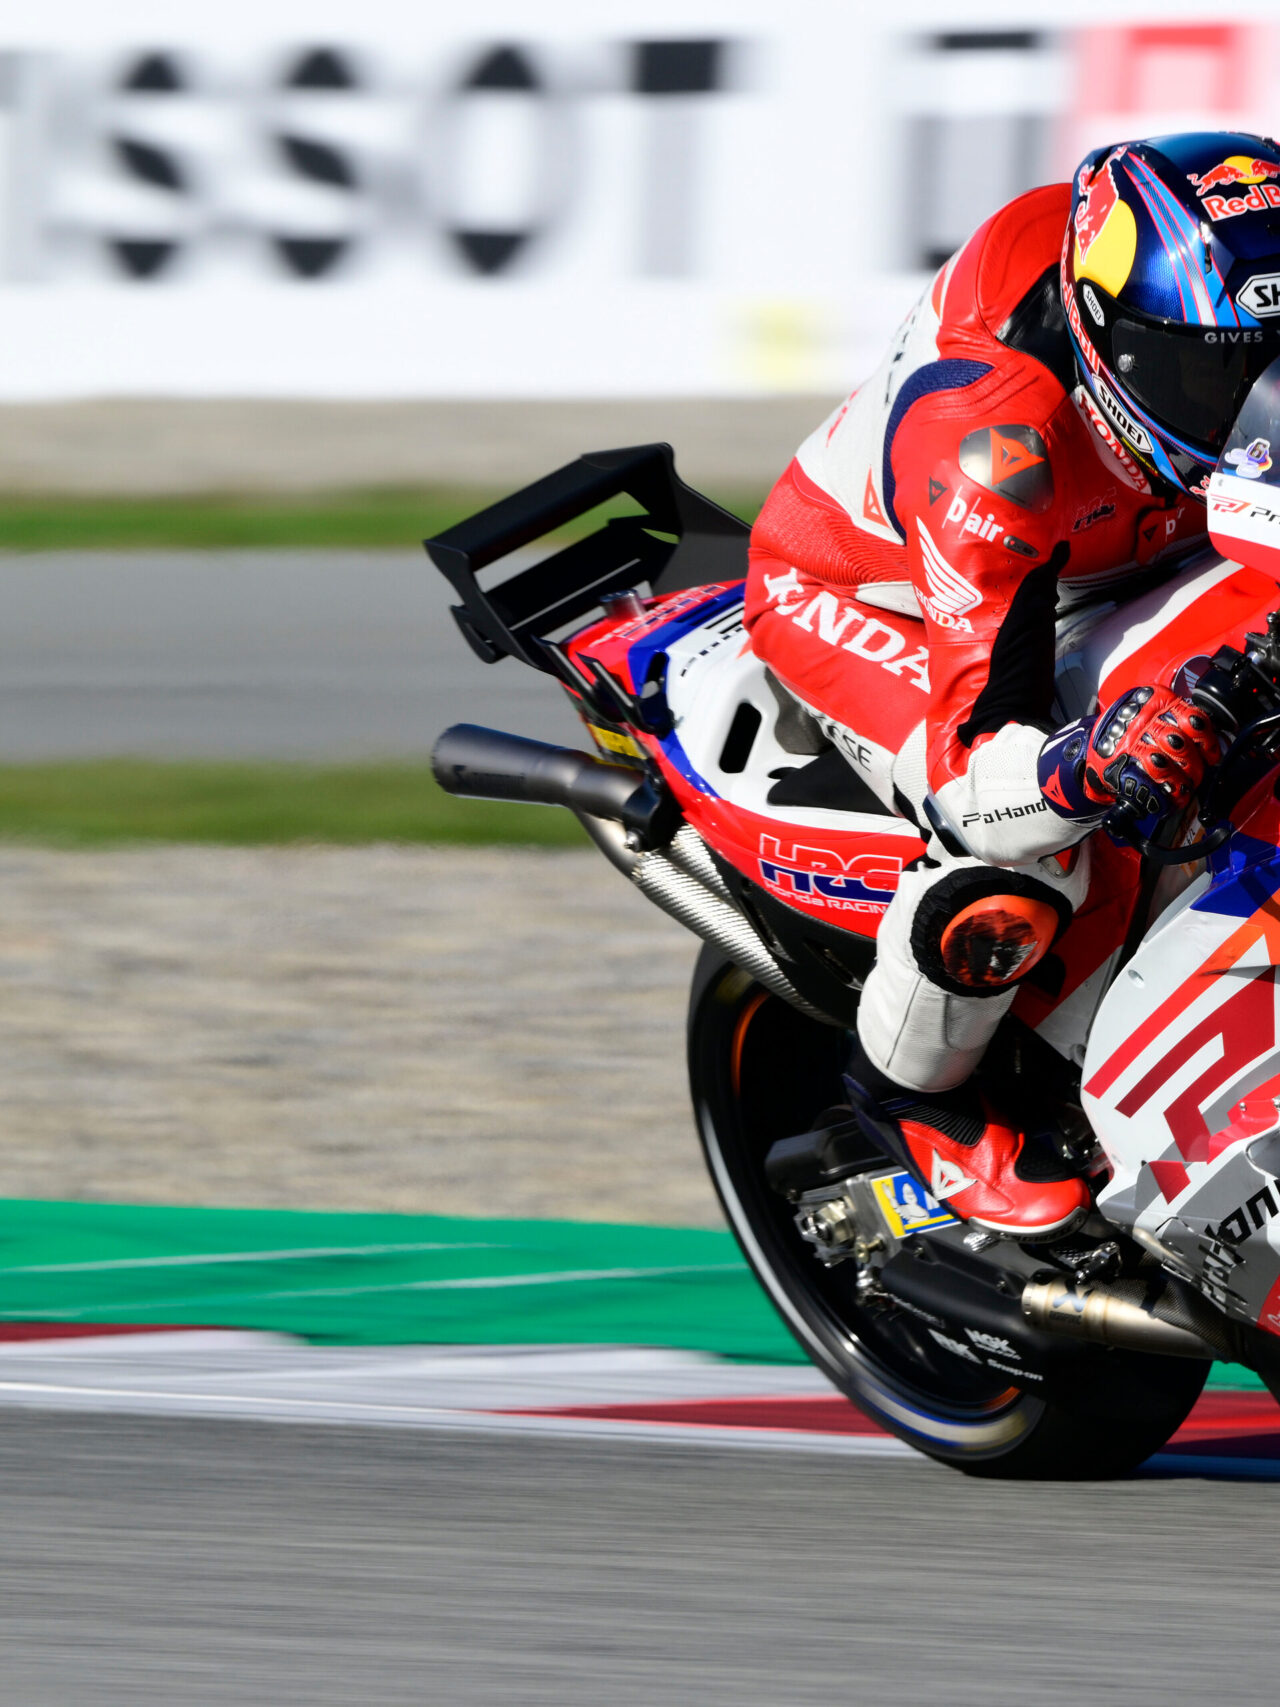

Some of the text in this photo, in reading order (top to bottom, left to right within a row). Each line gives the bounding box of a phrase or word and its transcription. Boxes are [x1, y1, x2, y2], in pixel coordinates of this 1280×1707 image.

[1201, 185, 1269, 222] Red
[1085, 289, 1103, 321] SHOEI
[1203, 331, 1264, 345] GIVES
[1099, 384, 1143, 446] SHOEI
[914, 585, 975, 634] HONDA
[758, 832, 903, 905] HRC
[763, 879, 888, 914] Honda RACIN
